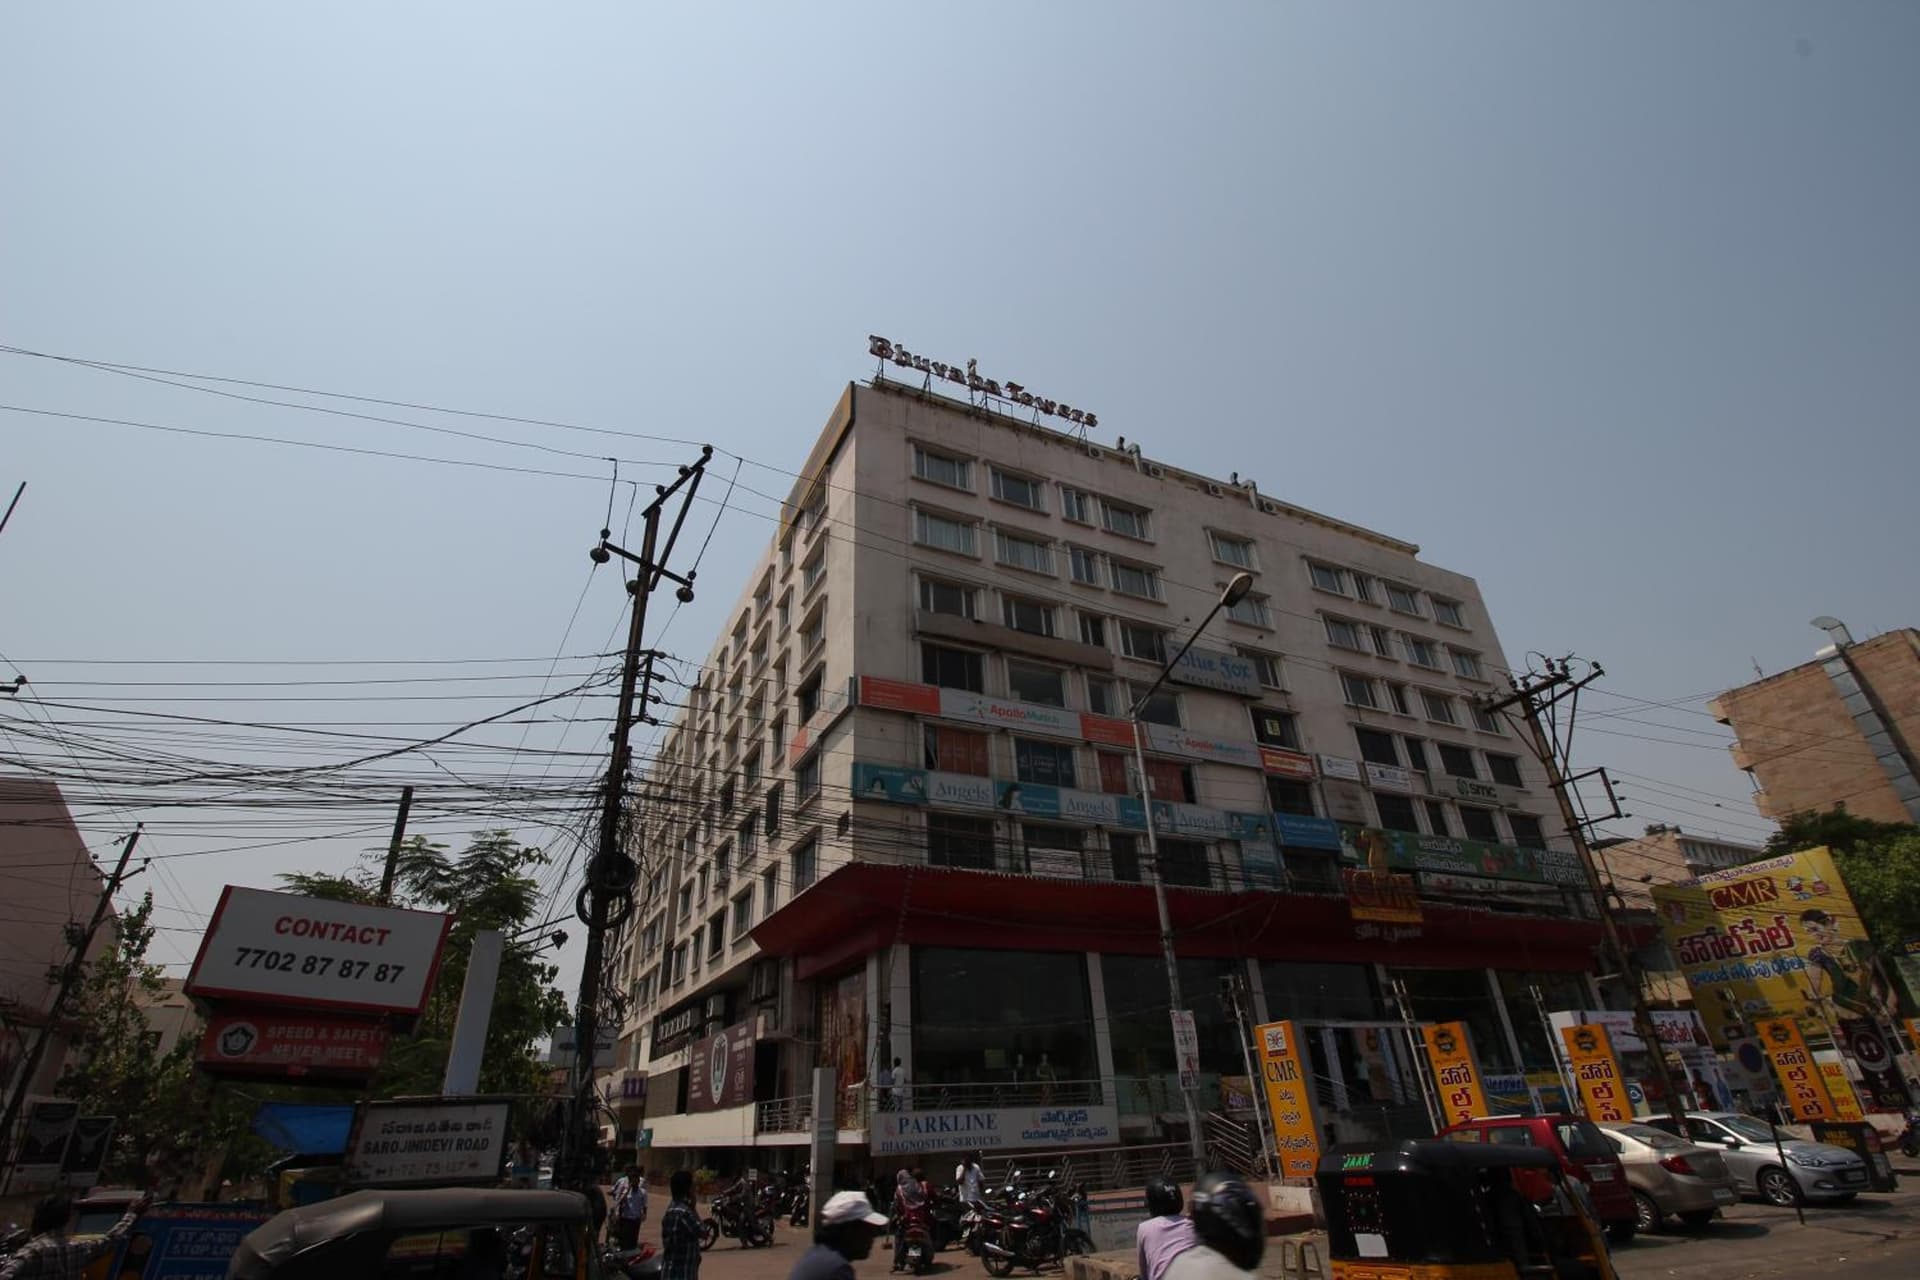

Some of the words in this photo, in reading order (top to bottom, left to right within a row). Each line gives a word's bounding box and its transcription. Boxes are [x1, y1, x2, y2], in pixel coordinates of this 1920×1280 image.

[1005, 381, 1098, 428] Towers
[1710, 881, 1776, 910] CMR
[275, 916, 391, 946] CONTACT
[233, 947, 295, 972] 7702
[300, 954, 334, 976] 87
[338, 959, 370, 979] 87
[374, 964, 405, 984] 87
[266, 1025, 315, 1041] SPEED
[333, 1027, 386, 1043] SAFETY
[271, 1043, 322, 1059] NEVER
[1265, 1060, 1298, 1082] CMR
[898, 1113, 998, 1135] PARKLINE
[362, 1138, 454, 1154] SAROJINIDEVI
[456, 1137, 490, 1152] ROAD
[881, 1139, 946, 1152] DIAGNOSTIC
[951, 1135, 1002, 1148] SERVICES
